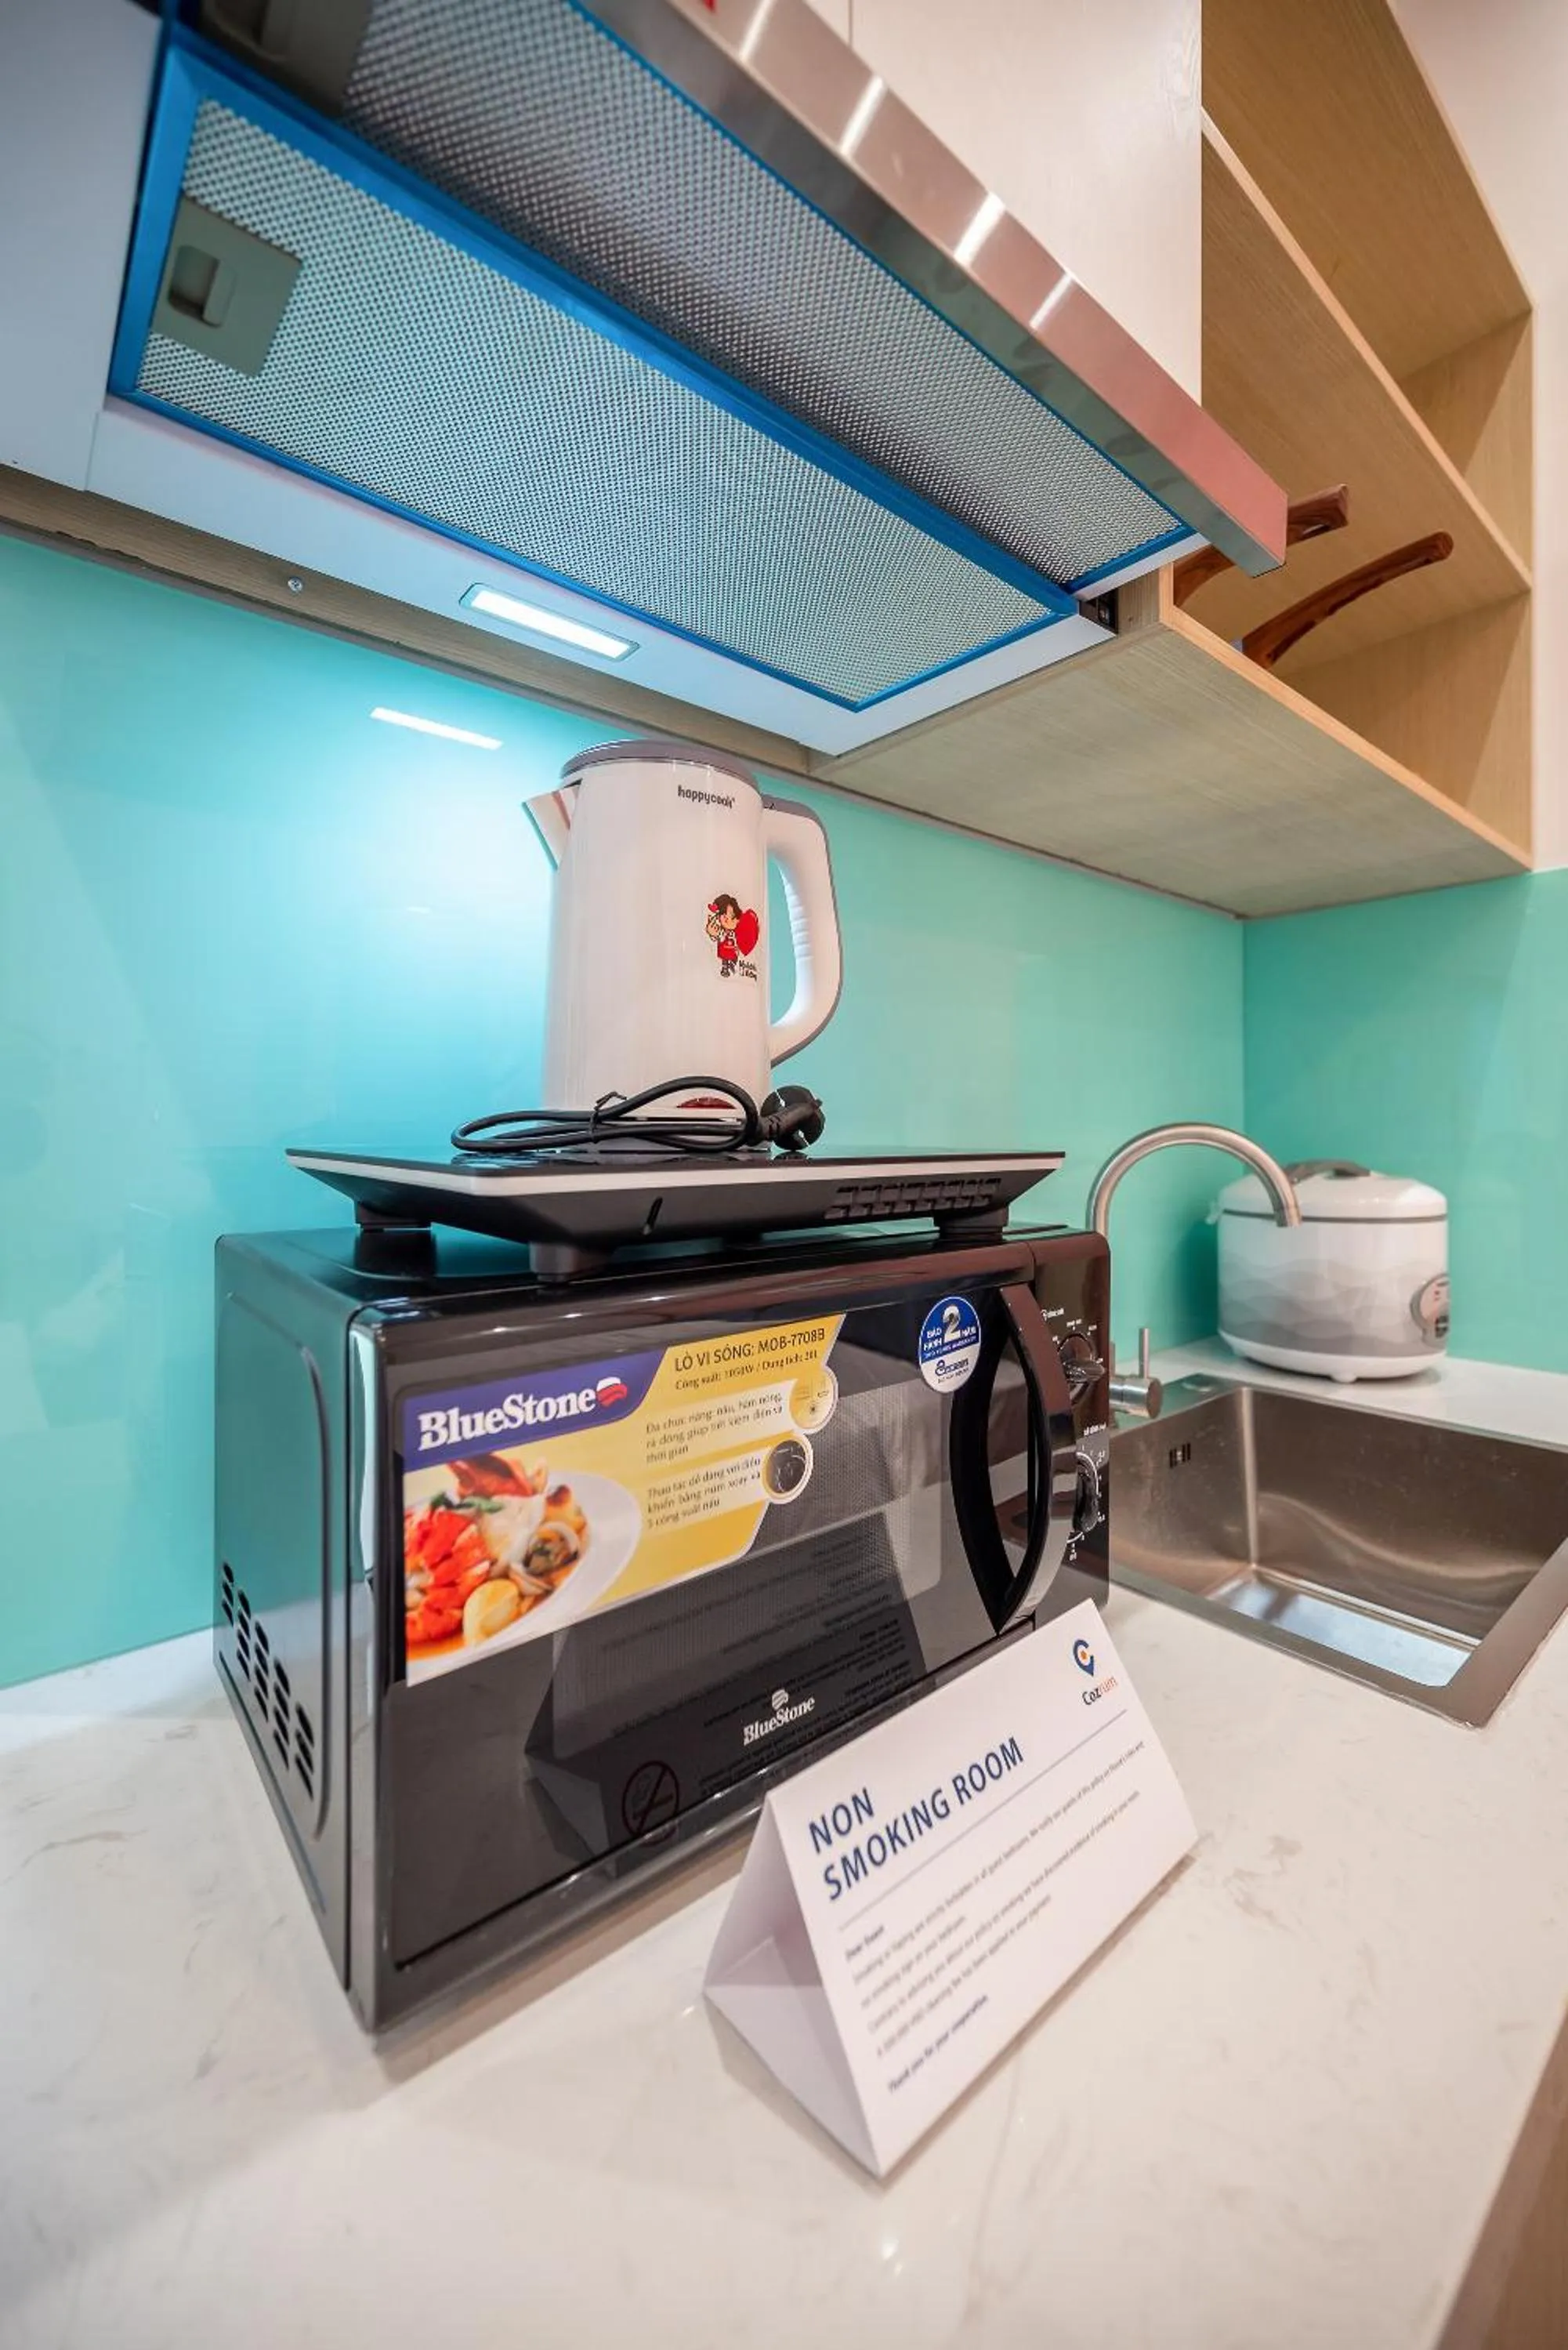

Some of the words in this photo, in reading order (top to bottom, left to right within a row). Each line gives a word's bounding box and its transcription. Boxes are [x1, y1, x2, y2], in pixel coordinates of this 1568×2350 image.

[675, 1352, 693, 1372] LÒ
[697, 1351, 710, 1367] VI
[714, 1343, 755, 1363] SÓNG:
[758, 1328, 824, 1353] MOB-7708B
[943, 1304, 961, 1342] 2
[418, 1389, 596, 1451] BlueStone
[744, 1697, 815, 1746] BlueStone
[808, 1787, 875, 1855] NON
[824, 1788, 951, 1902] SMOKING
[951, 1736, 1024, 1806] ROOM
